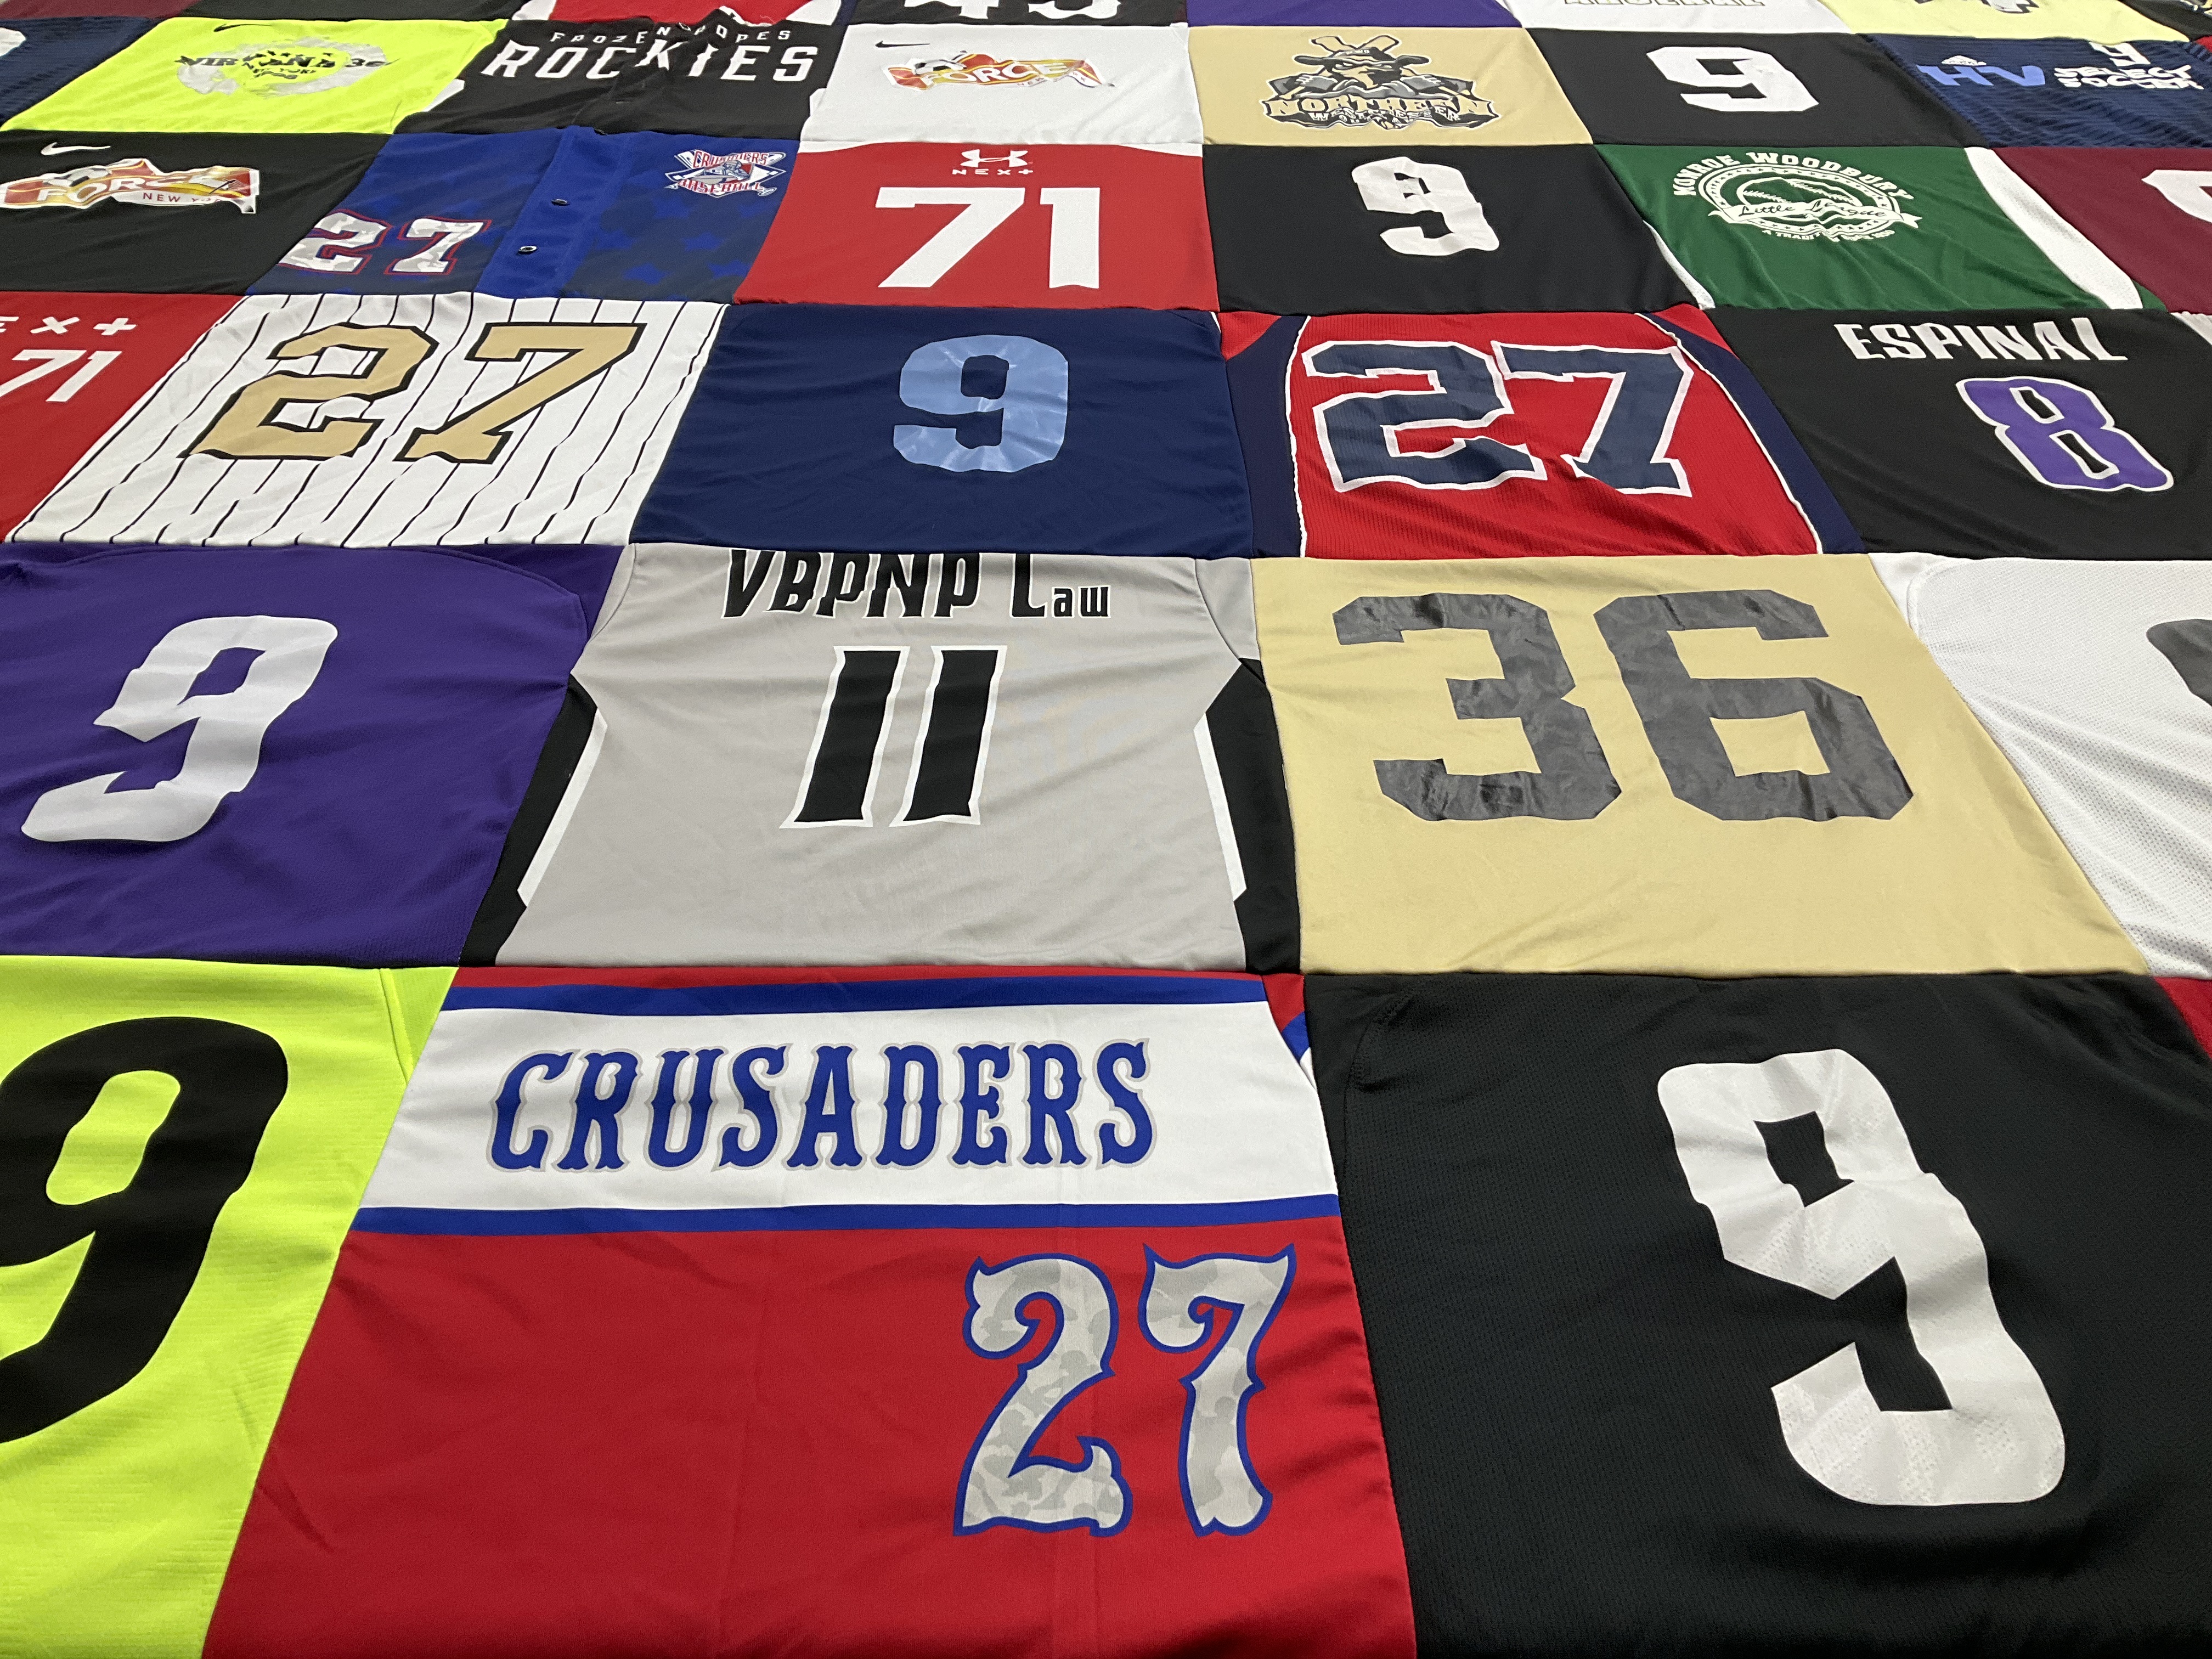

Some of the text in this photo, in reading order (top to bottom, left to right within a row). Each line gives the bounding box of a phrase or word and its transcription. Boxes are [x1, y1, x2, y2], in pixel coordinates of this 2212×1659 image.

[481, 39, 818, 81] ROCKIES
[1269, 94, 1489, 116] NORTHERN
[1646, 46, 1819, 112] 9
[1915, 65, 2046, 87] HV
[2054, 65, 2192, 79] SELECT
[143, 193, 180, 202] NEW
[1351, 156, 1500, 256] 9
[1673, 152, 1915, 200] MONROE WOODBURY
[1738, 205, 1796, 217] Little
[276, 208, 492, 275] 27
[875, 187, 1101, 289] 71
[0, 349, 122, 402] 71
[1833, 317, 2128, 360] ESPINAL
[177, 321, 648, 464] 27
[893, 334, 1069, 473] 9
[1301, 340, 1694, 498] 27
[1955, 376, 2175, 492] 8
[720, 548, 983, 619] VBPNP
[21, 614, 338, 842] 9
[778, 645, 1008, 829] 11
[1331, 589, 1914, 822] 36
[486, 1037, 1158, 1173] CRUSADERS
[0, 1016, 289, 1444] 9
[1657, 1048, 2066, 1506] 9
[953, 1242, 1295, 1538] 27
